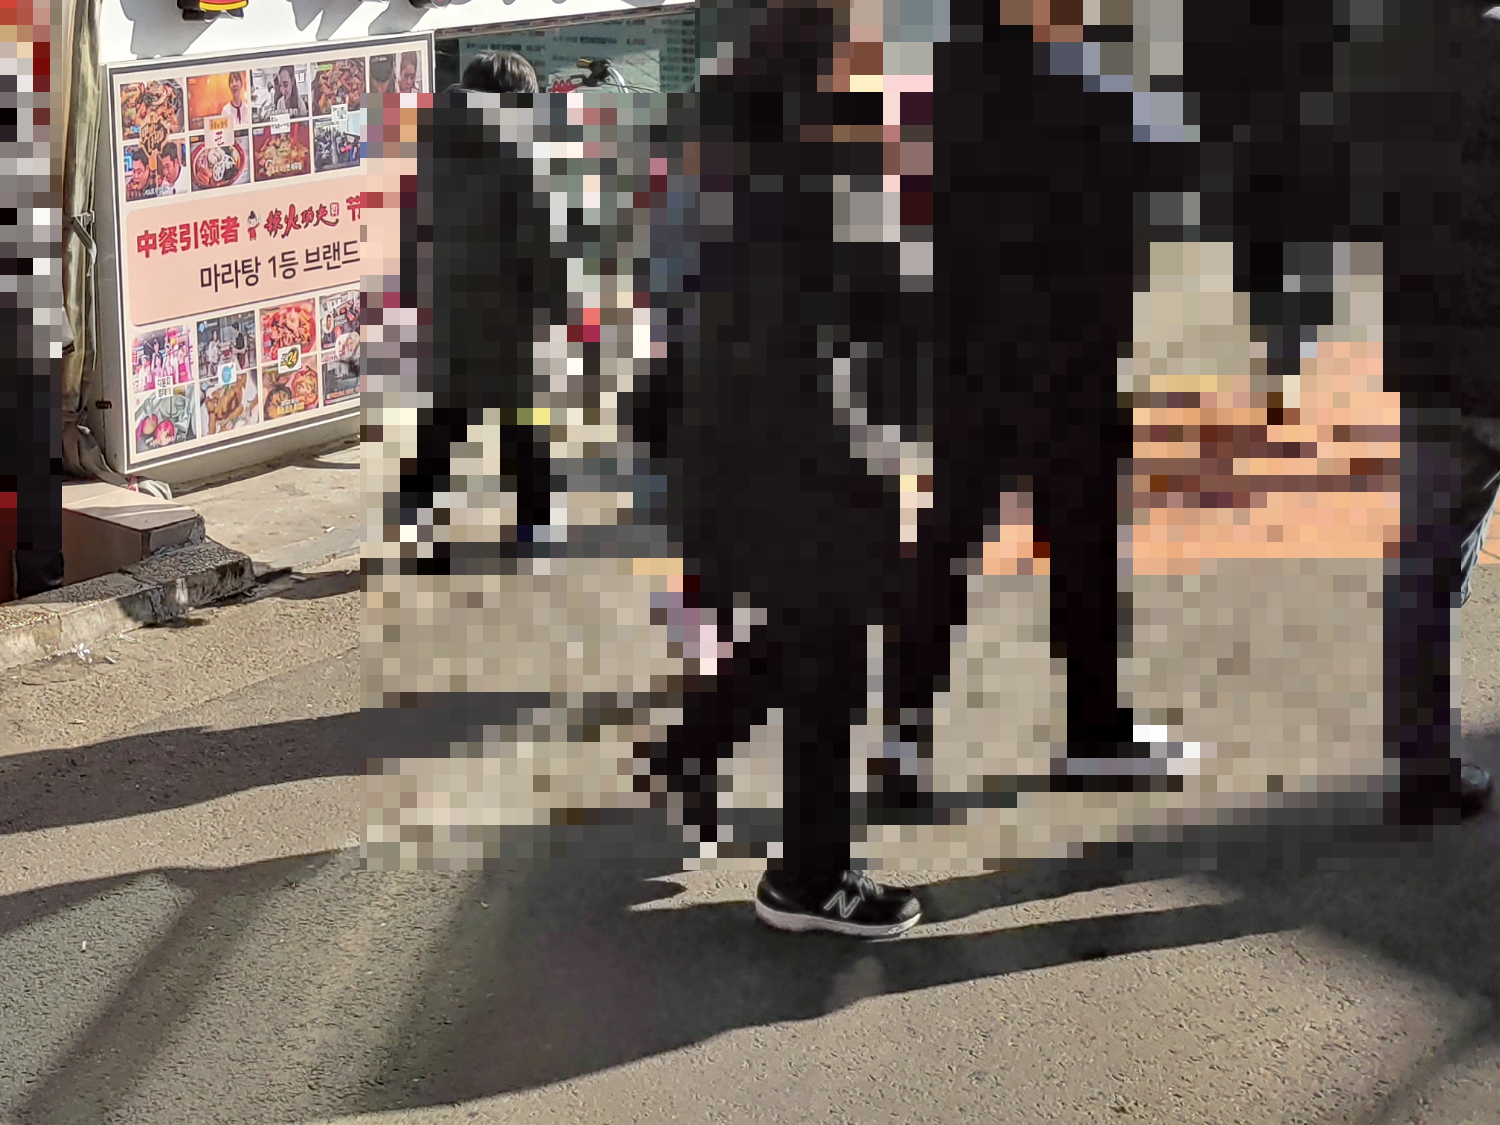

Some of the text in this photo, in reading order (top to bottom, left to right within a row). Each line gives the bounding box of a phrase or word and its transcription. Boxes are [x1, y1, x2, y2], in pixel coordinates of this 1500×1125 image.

[136, 215, 240, 259] 中餐引领者
[200, 239, 360, 293] 마라탕 1등 브랜드
